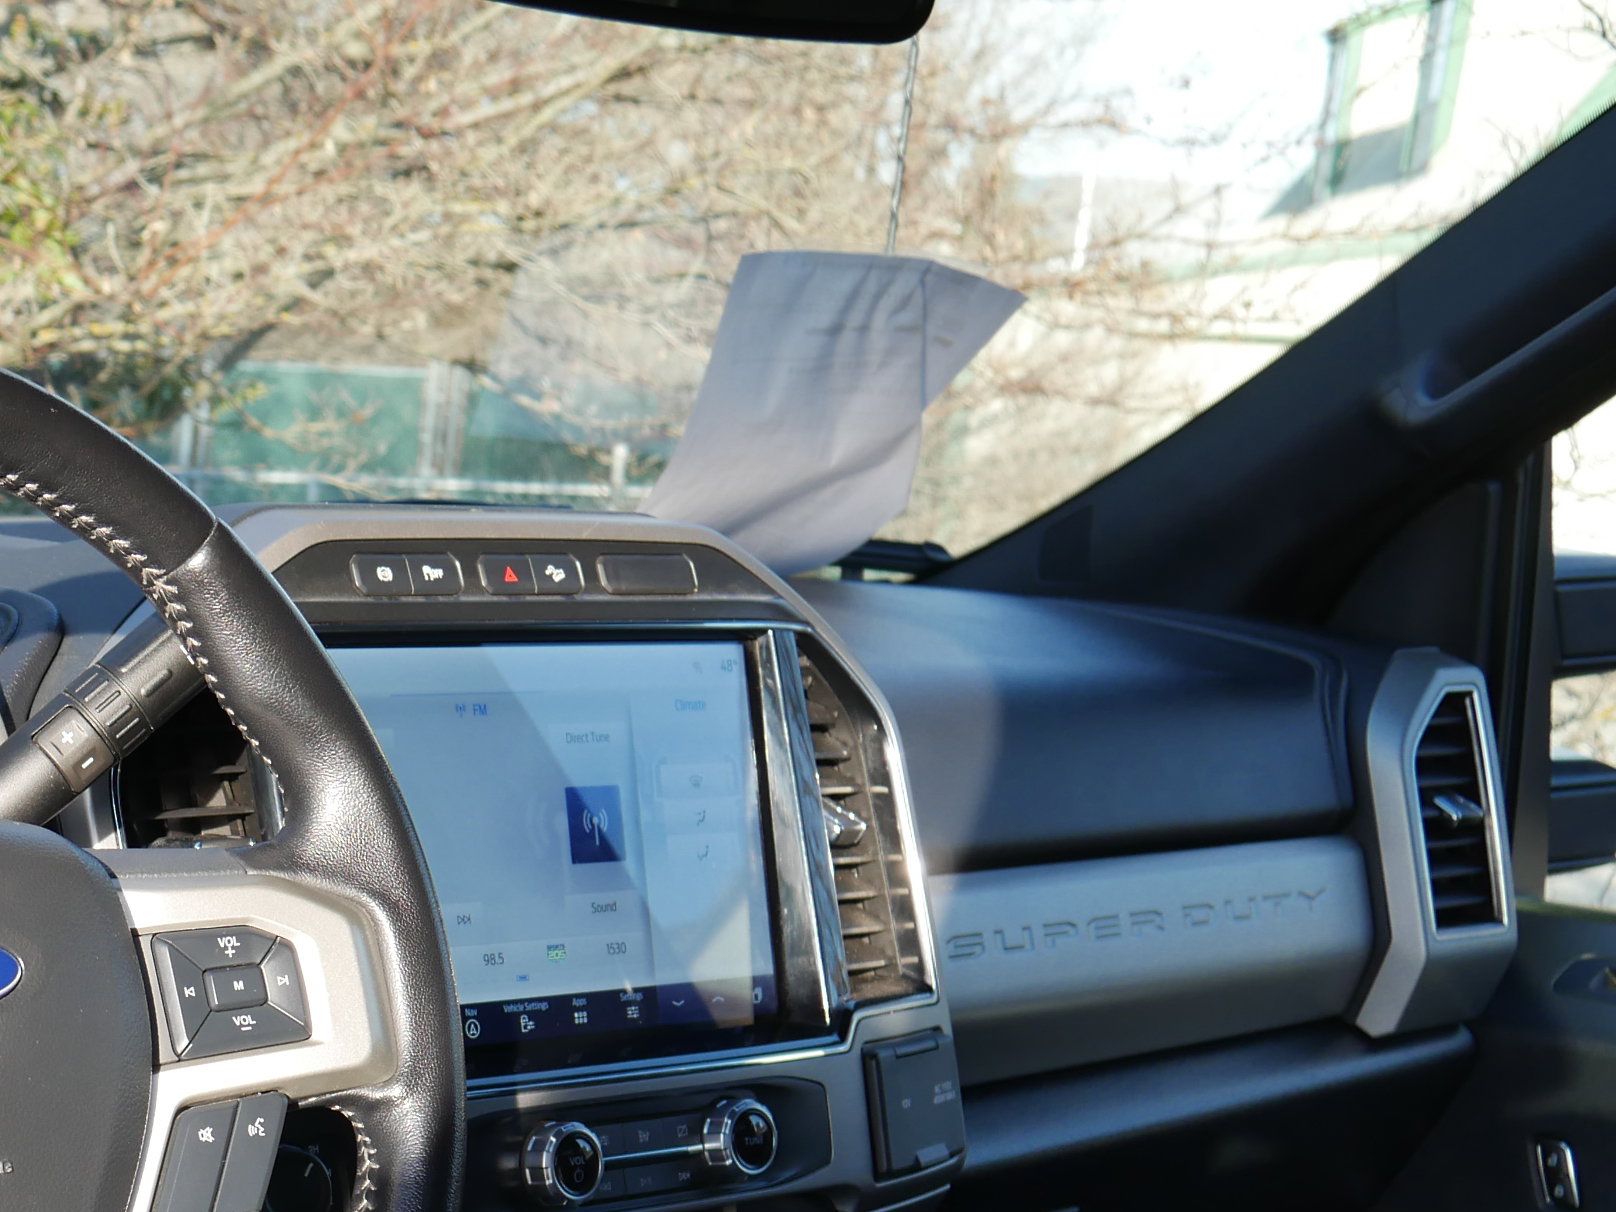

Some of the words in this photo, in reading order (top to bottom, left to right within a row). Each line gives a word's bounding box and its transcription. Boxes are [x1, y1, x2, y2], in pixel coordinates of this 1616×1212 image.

[472, 704, 488, 716] FM
[674, 698, 706, 712] Climate
[565, 731, 588, 745] Direct
[590, 731, 610, 744] Tune
[591, 901, 617, 914] Sound
[946, 909, 1166, 960] SUPER
[1182, 886, 1326, 927] DUTY
[217, 936, 241, 948] VOL
[606, 942, 627, 955] 1530
[483, 952, 505, 966] 98.5
[233, 980, 244, 991] M
[503, 1004, 524, 1013] Vehicle
[524, 1001, 549, 1011] Settings
[572, 997, 587, 1007] Apps
[464, 1007, 478, 1016] Nav
[232, 1015, 257, 1026] VOL
